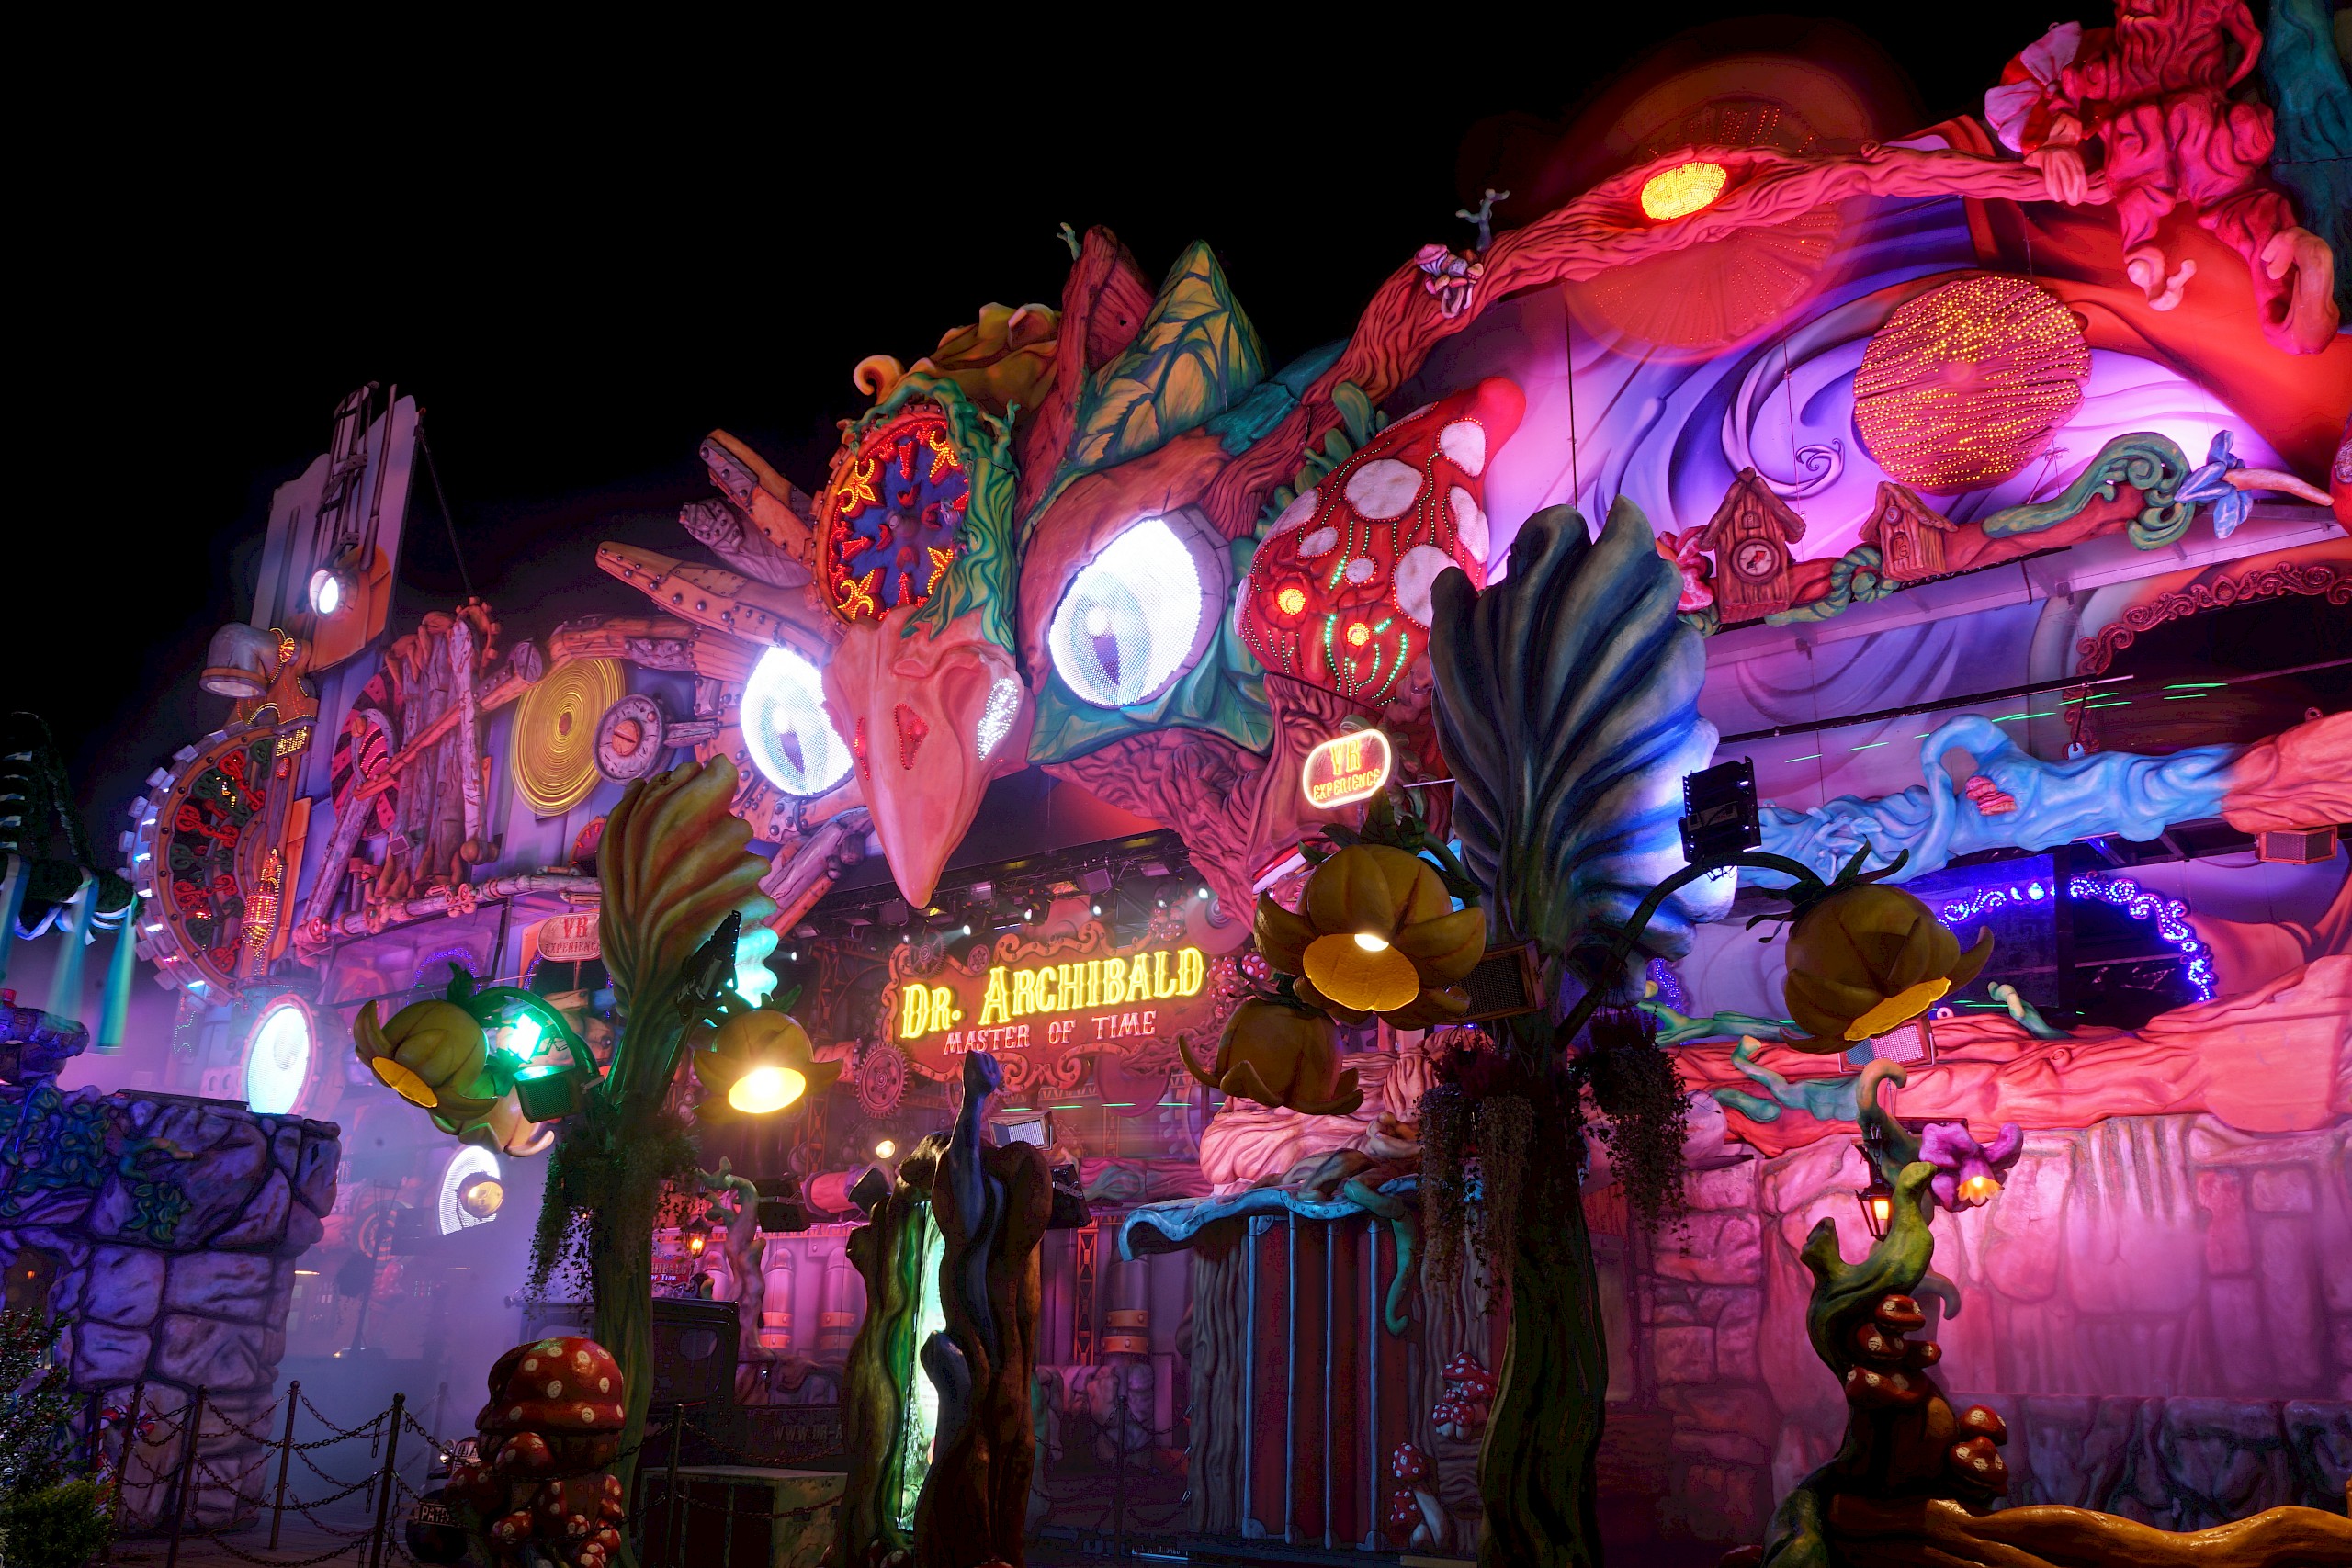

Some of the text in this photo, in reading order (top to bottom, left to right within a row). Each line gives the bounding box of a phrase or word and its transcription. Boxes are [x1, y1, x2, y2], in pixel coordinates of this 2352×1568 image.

[1330, 739, 1361, 775] VR
[1313, 768, 1381, 801] EXPERIENCE
[563, 916, 589, 938] VR
[980, 946, 1205, 1026] ARCHIBALD
[944, 1010, 1157, 1055] MASTER OF TIME
